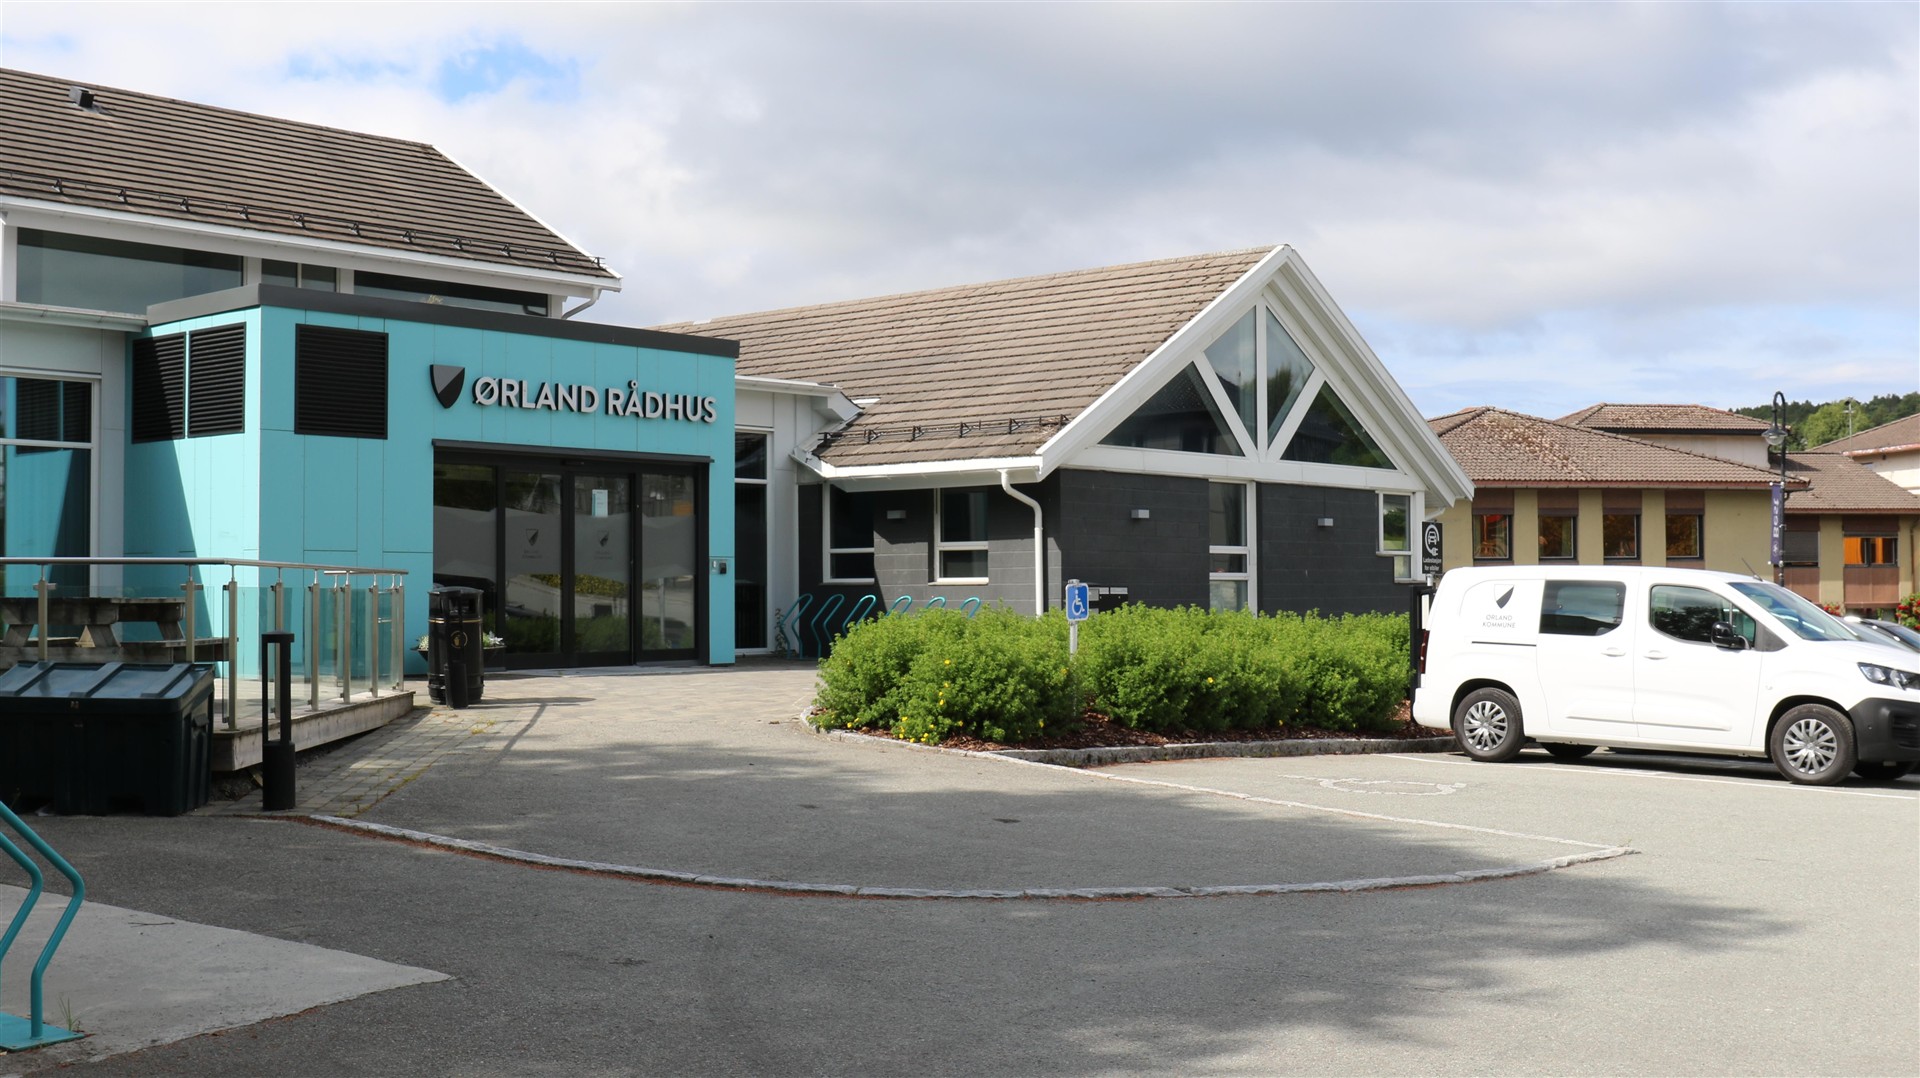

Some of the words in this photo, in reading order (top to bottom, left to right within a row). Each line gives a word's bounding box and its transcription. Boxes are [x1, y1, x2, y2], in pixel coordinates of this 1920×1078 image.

[473, 376, 599, 413] ØRLAND
[605, 380, 717, 423] RÅDHUS
[1482, 621, 1516, 629] KOMMUNE
